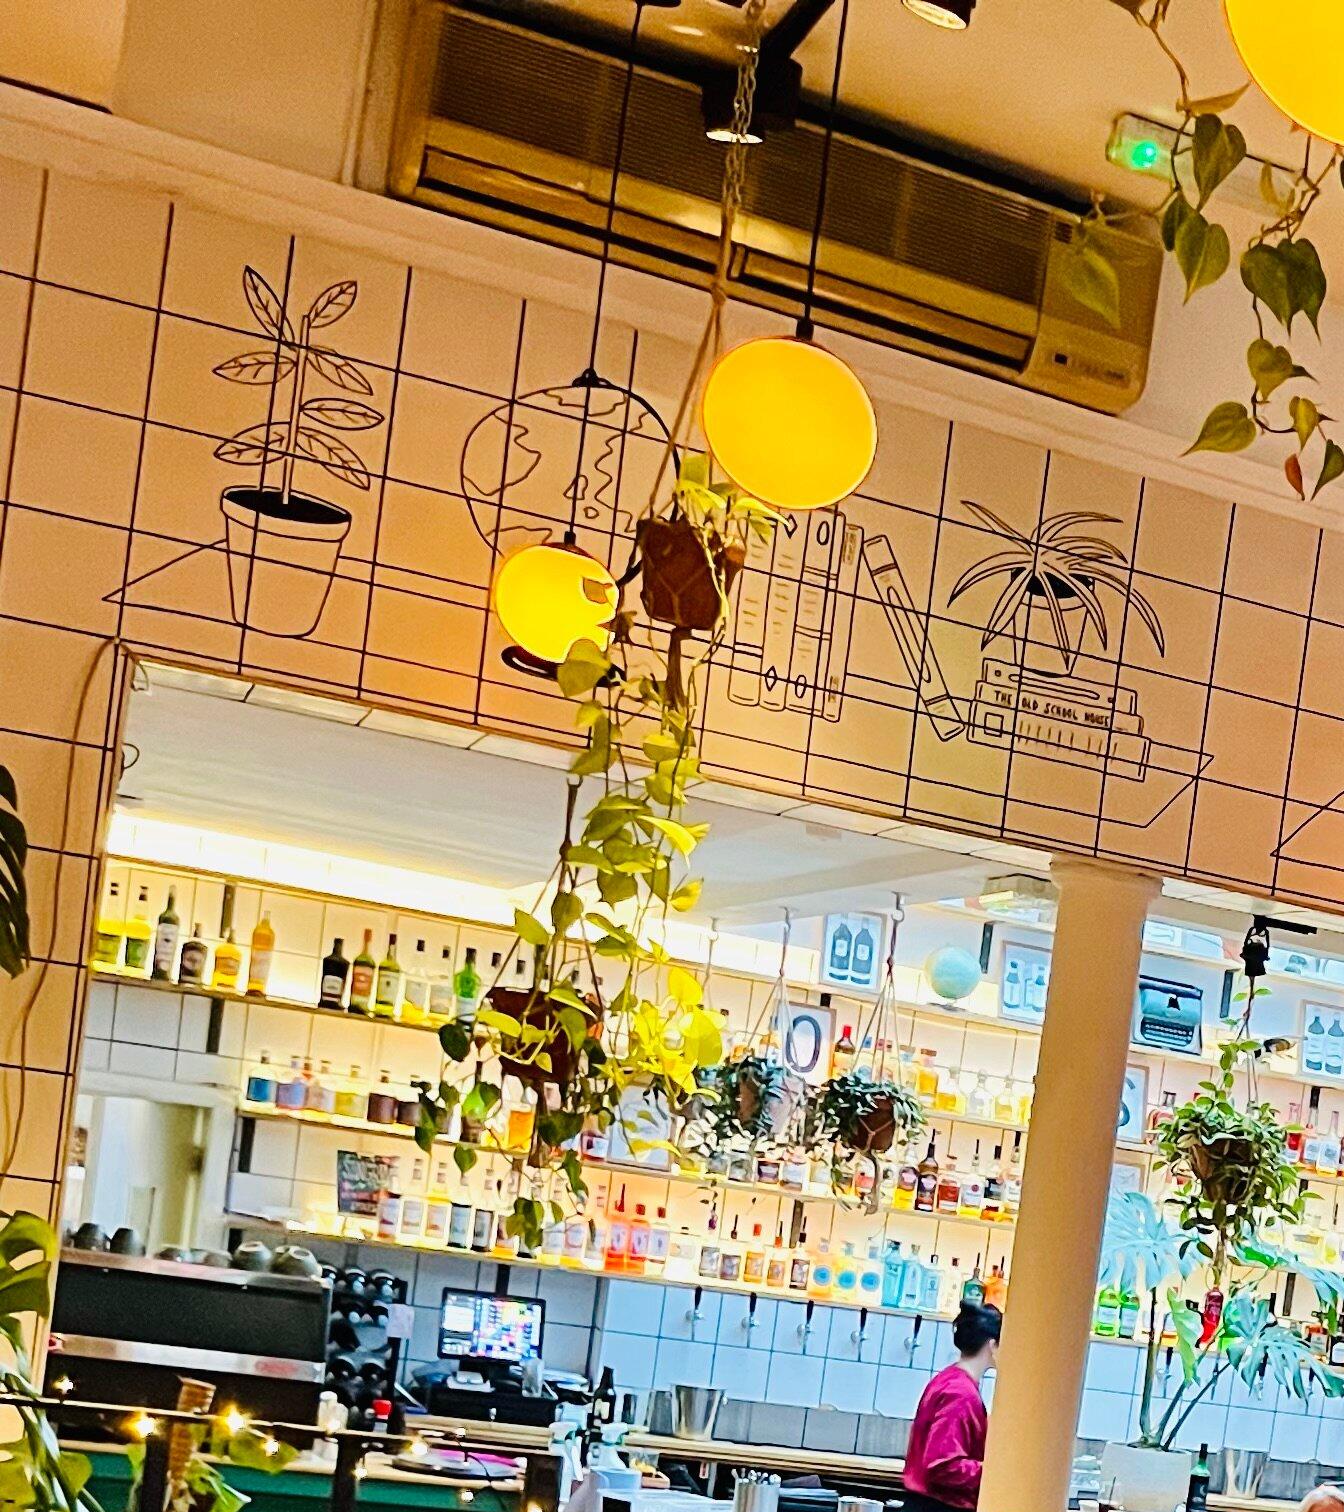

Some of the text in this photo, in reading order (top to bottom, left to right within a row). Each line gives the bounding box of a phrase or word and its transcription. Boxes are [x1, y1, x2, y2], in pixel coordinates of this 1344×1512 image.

[994, 689, 1013, 707] THE
[1021, 697, 1039, 712] OLD
[1044, 702, 1078, 721] SCHOOL
